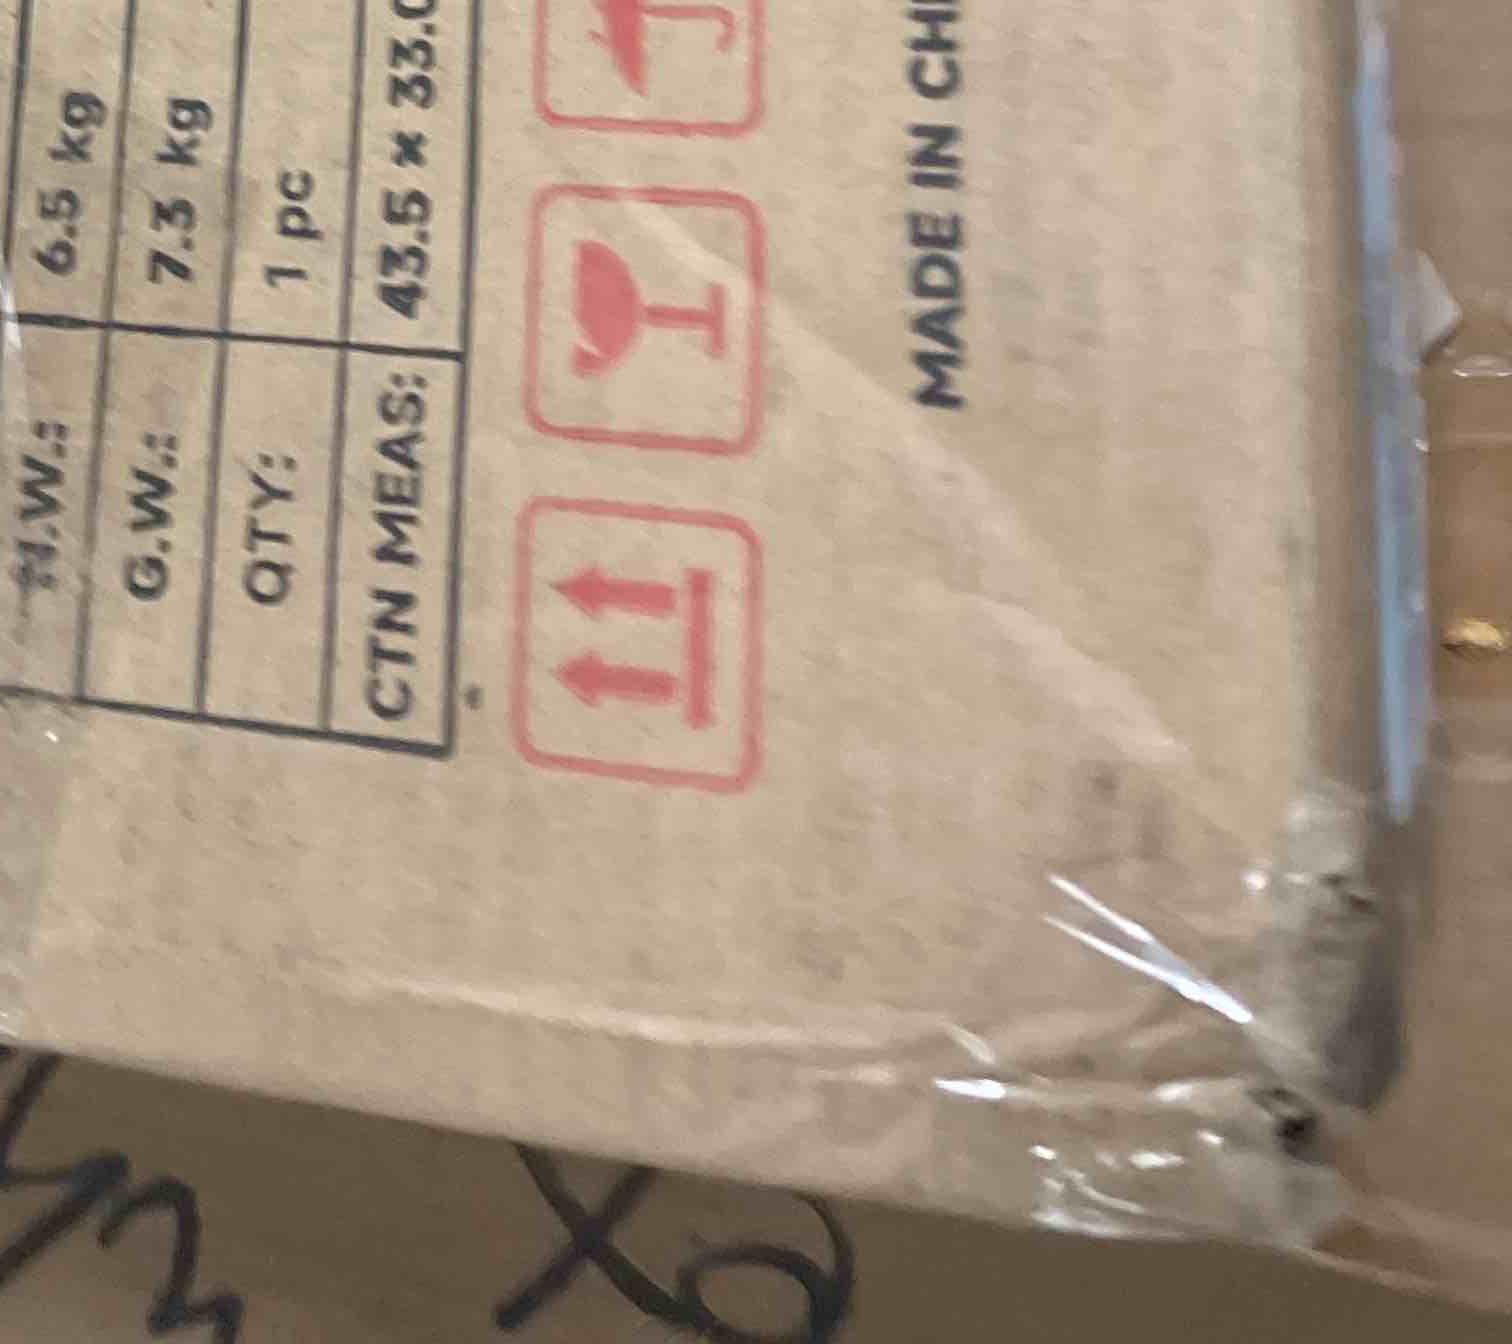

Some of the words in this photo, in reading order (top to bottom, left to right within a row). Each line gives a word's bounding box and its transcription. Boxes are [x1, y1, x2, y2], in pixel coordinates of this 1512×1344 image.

[48, 90, 108, 163] kg
[156, 97, 215, 166] kg
[907, 123, 963, 189] IN
[33, 189, 82, 276] 6.5
[146, 198, 198, 285] 7.3
[276, 168, 323, 242] pc
[264, 265, 308, 289] 1
[377, 189, 433, 319] 43.5
[909, 212, 965, 410] MADE
[372, 373, 428, 566] MEAS:
[124, 432, 178, 601] G.W.:
[243, 452, 296, 606] QTY:
[366, 589, 419, 720] CTN
